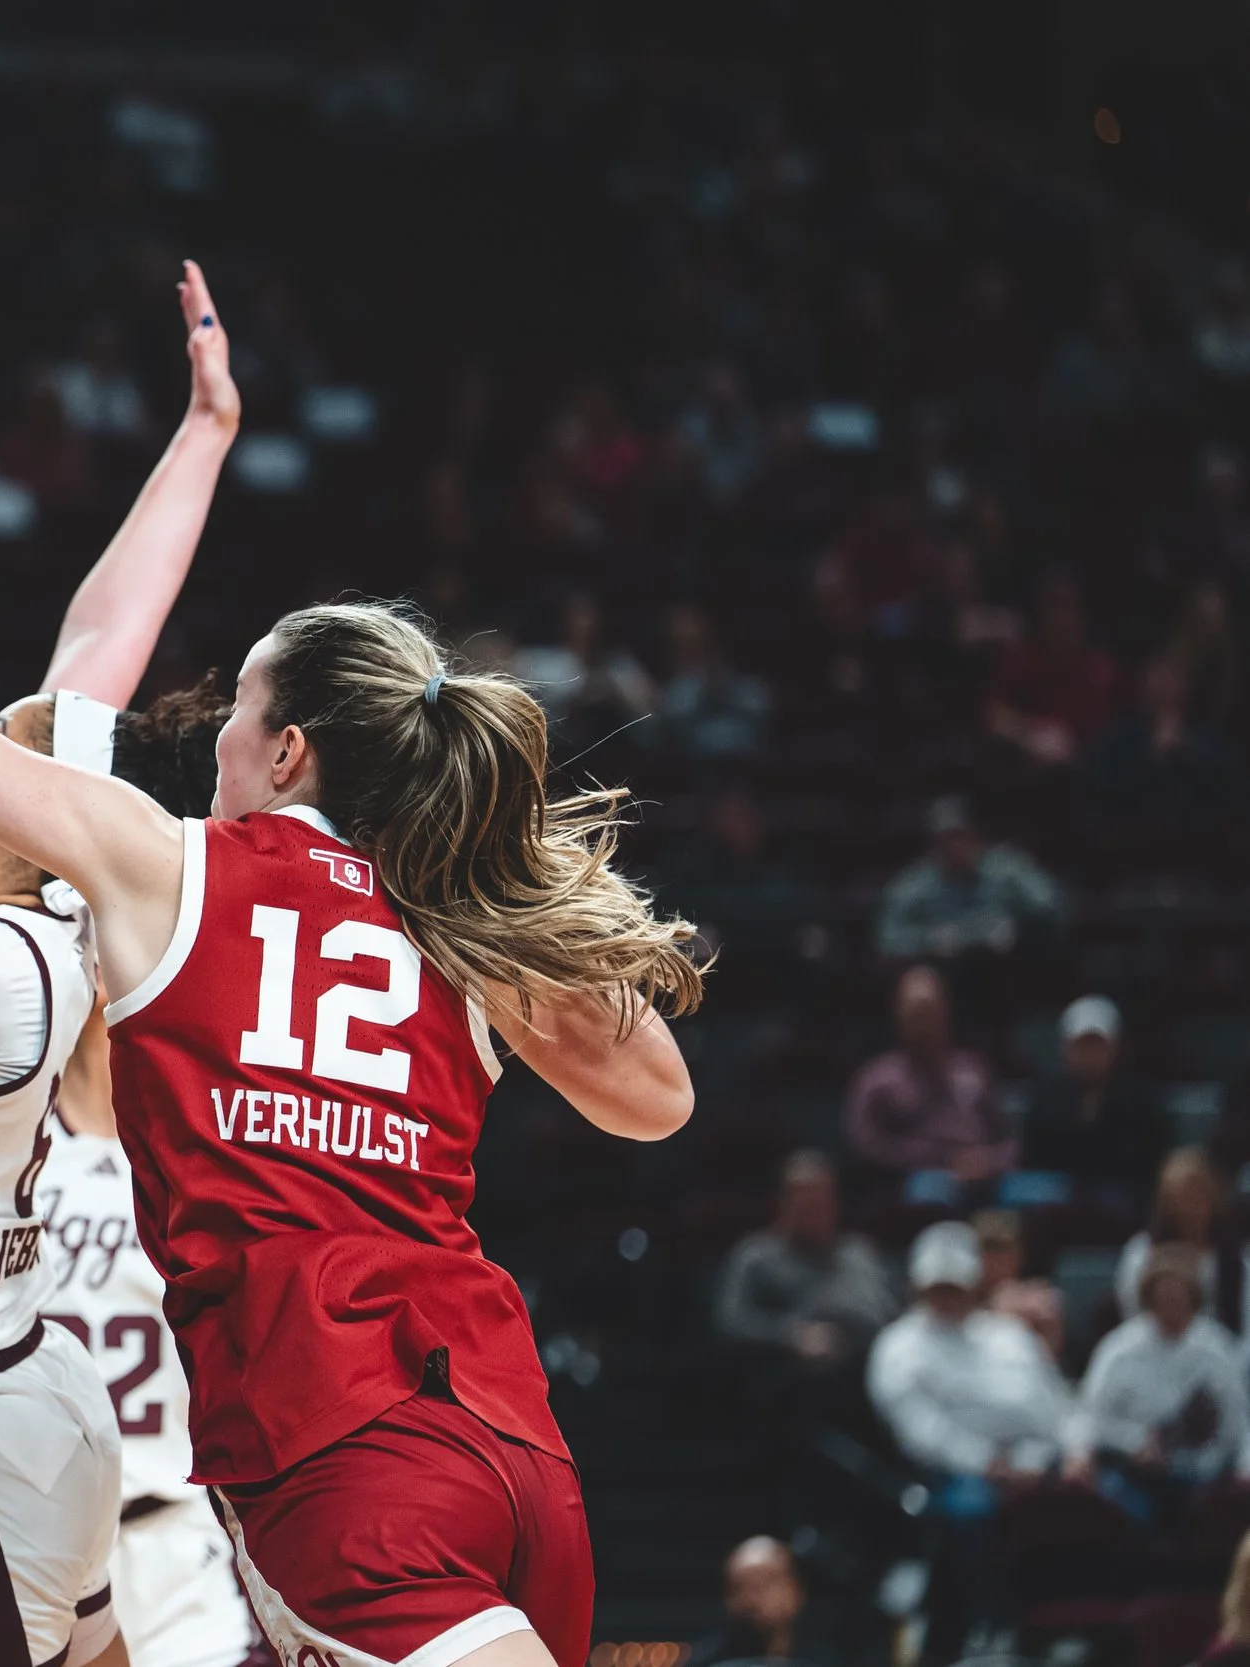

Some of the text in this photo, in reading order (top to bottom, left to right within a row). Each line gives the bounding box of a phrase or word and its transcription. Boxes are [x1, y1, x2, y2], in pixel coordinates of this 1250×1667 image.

[239, 903, 422, 1094] 12
[211, 1088, 429, 1171] VERHULST
[39, 1314, 162, 1435] 2
